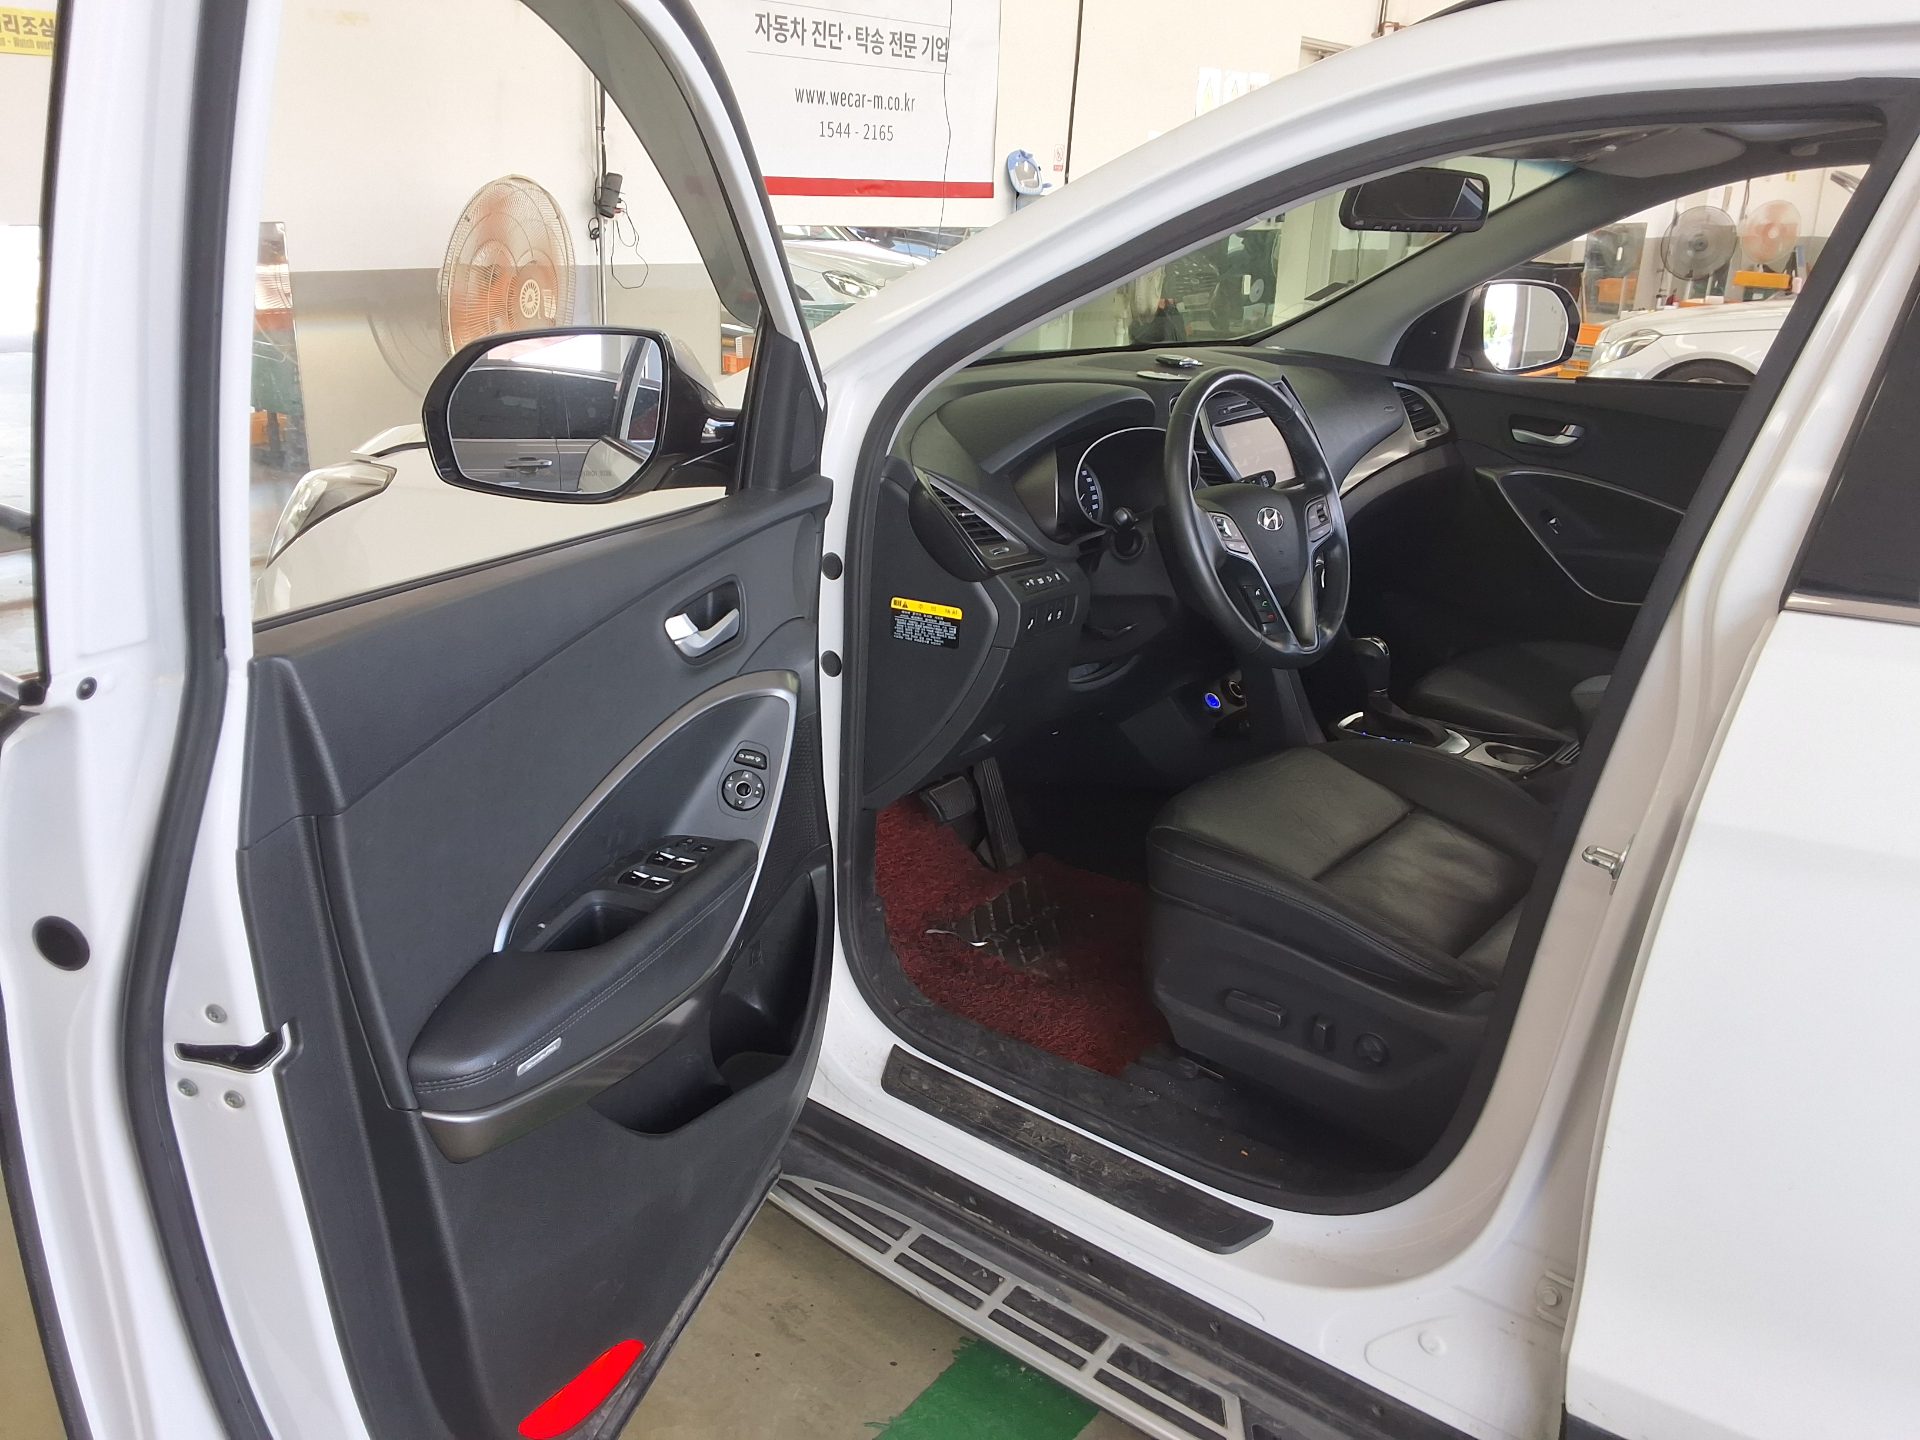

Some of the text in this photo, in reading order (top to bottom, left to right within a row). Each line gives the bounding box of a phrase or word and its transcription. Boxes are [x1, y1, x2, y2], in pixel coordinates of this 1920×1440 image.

[0, 14, 54, 38] 리조심
[754, 12, 807, 45] 자동차
[888, 31, 918, 60] 전문
[921, 35, 950, 63] 기업
[795, 88, 915, 111] www.wecar-m.co.kr
